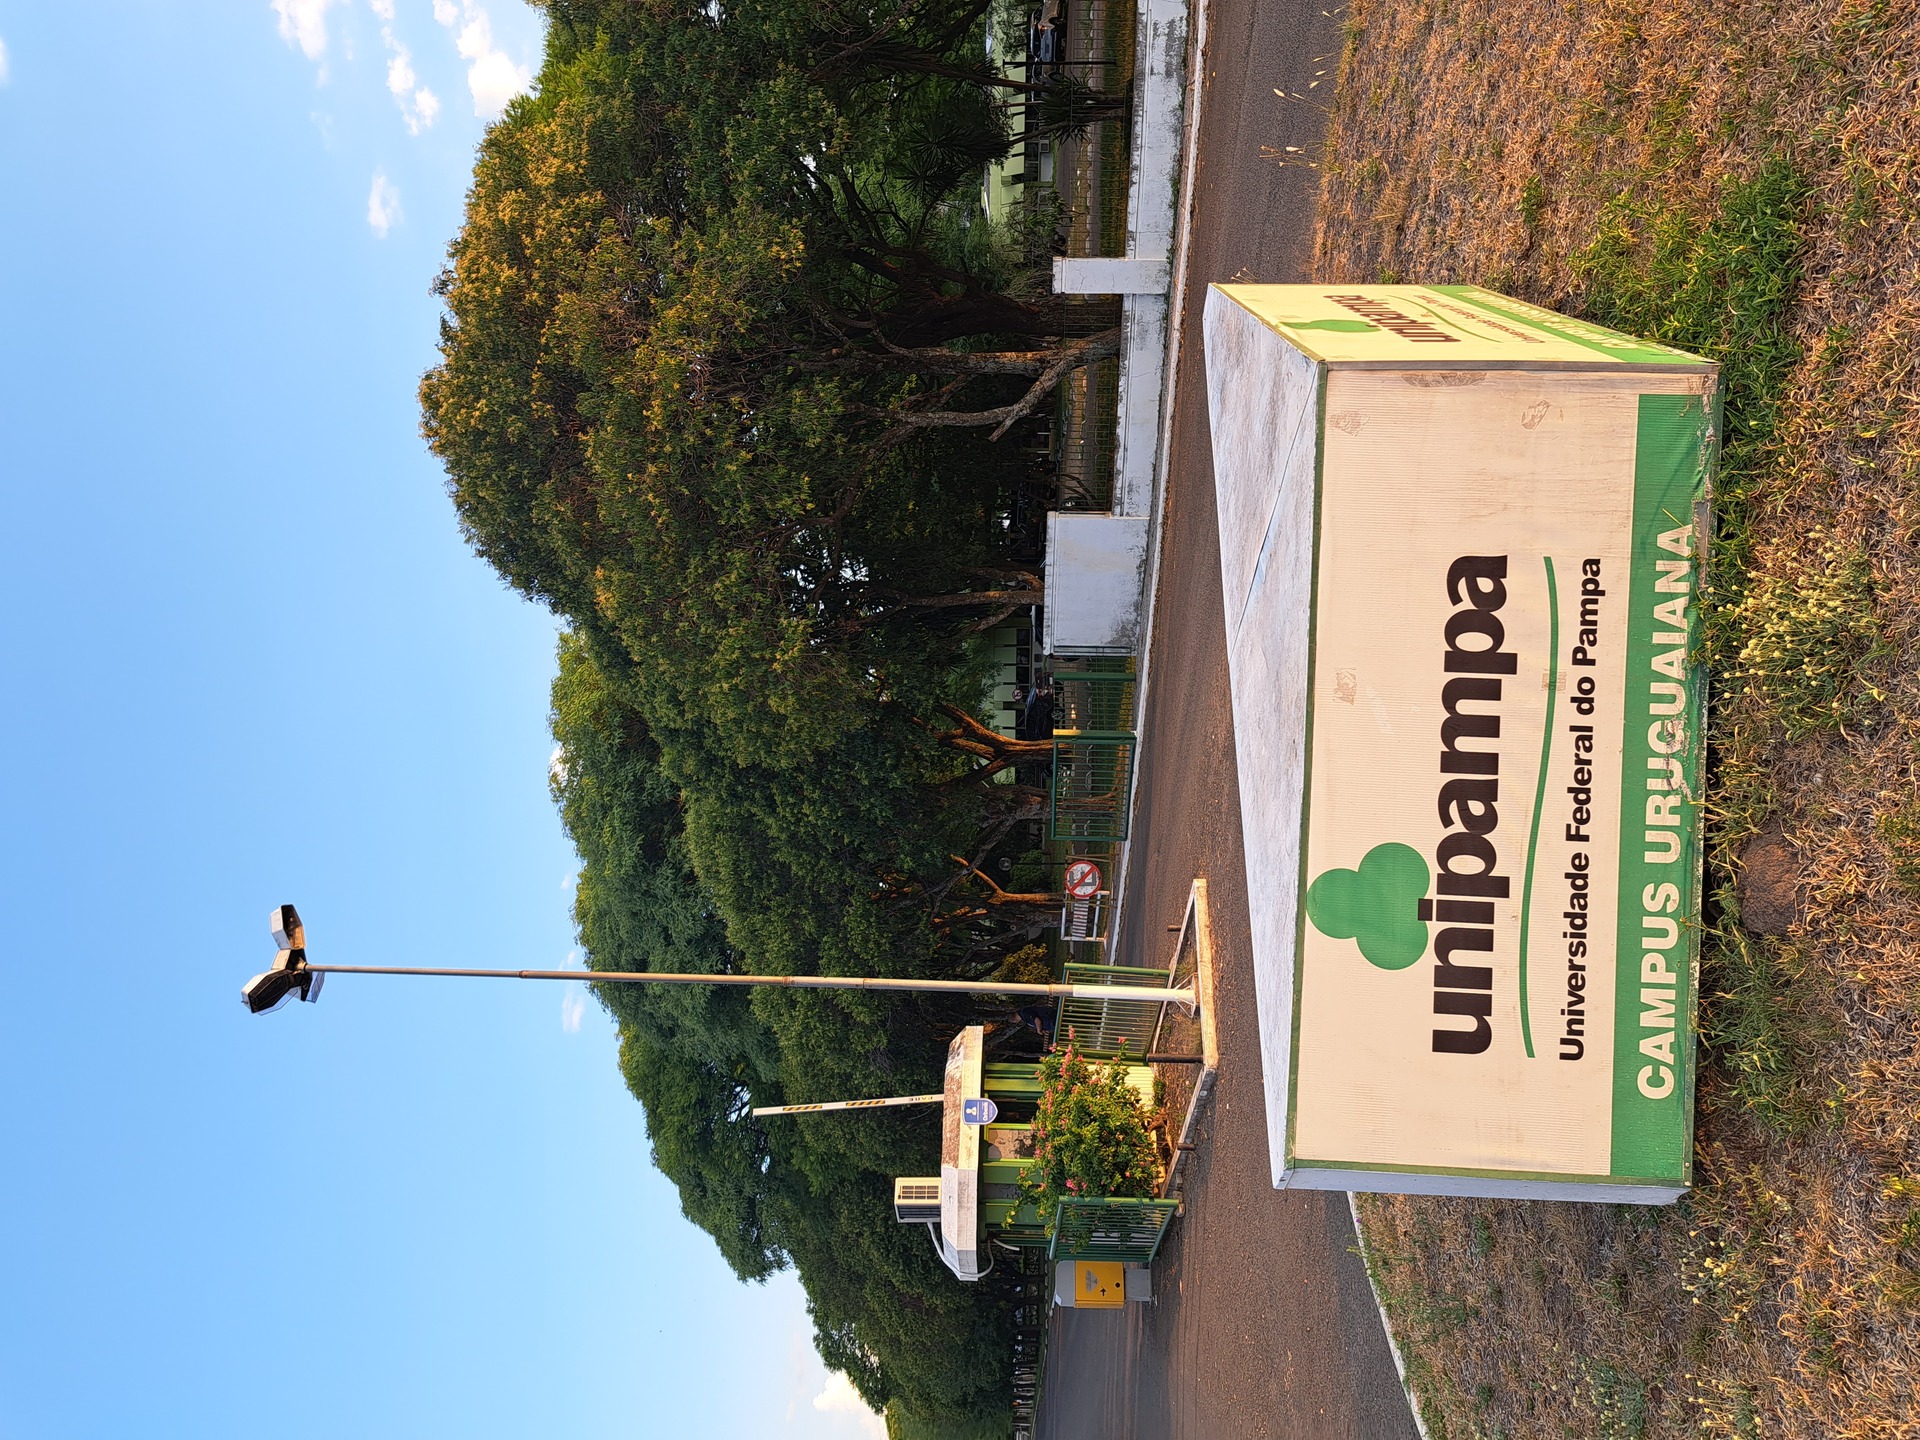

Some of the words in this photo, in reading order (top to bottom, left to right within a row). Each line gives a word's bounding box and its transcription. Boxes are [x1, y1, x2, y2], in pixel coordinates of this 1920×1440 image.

[1323, 294, 1462, 343] unipampa
[1571, 558, 1606, 666] Pampa
[1644, 523, 1693, 864] URUGUAIANA
[1569, 676, 1596, 716] do
[1417, 554, 1518, 1055] unipampa
[1565, 725, 1594, 842] Federal
[1559, 852, 1590, 1061] Universidade
[1637, 882, 1680, 1100] CAMPUS
